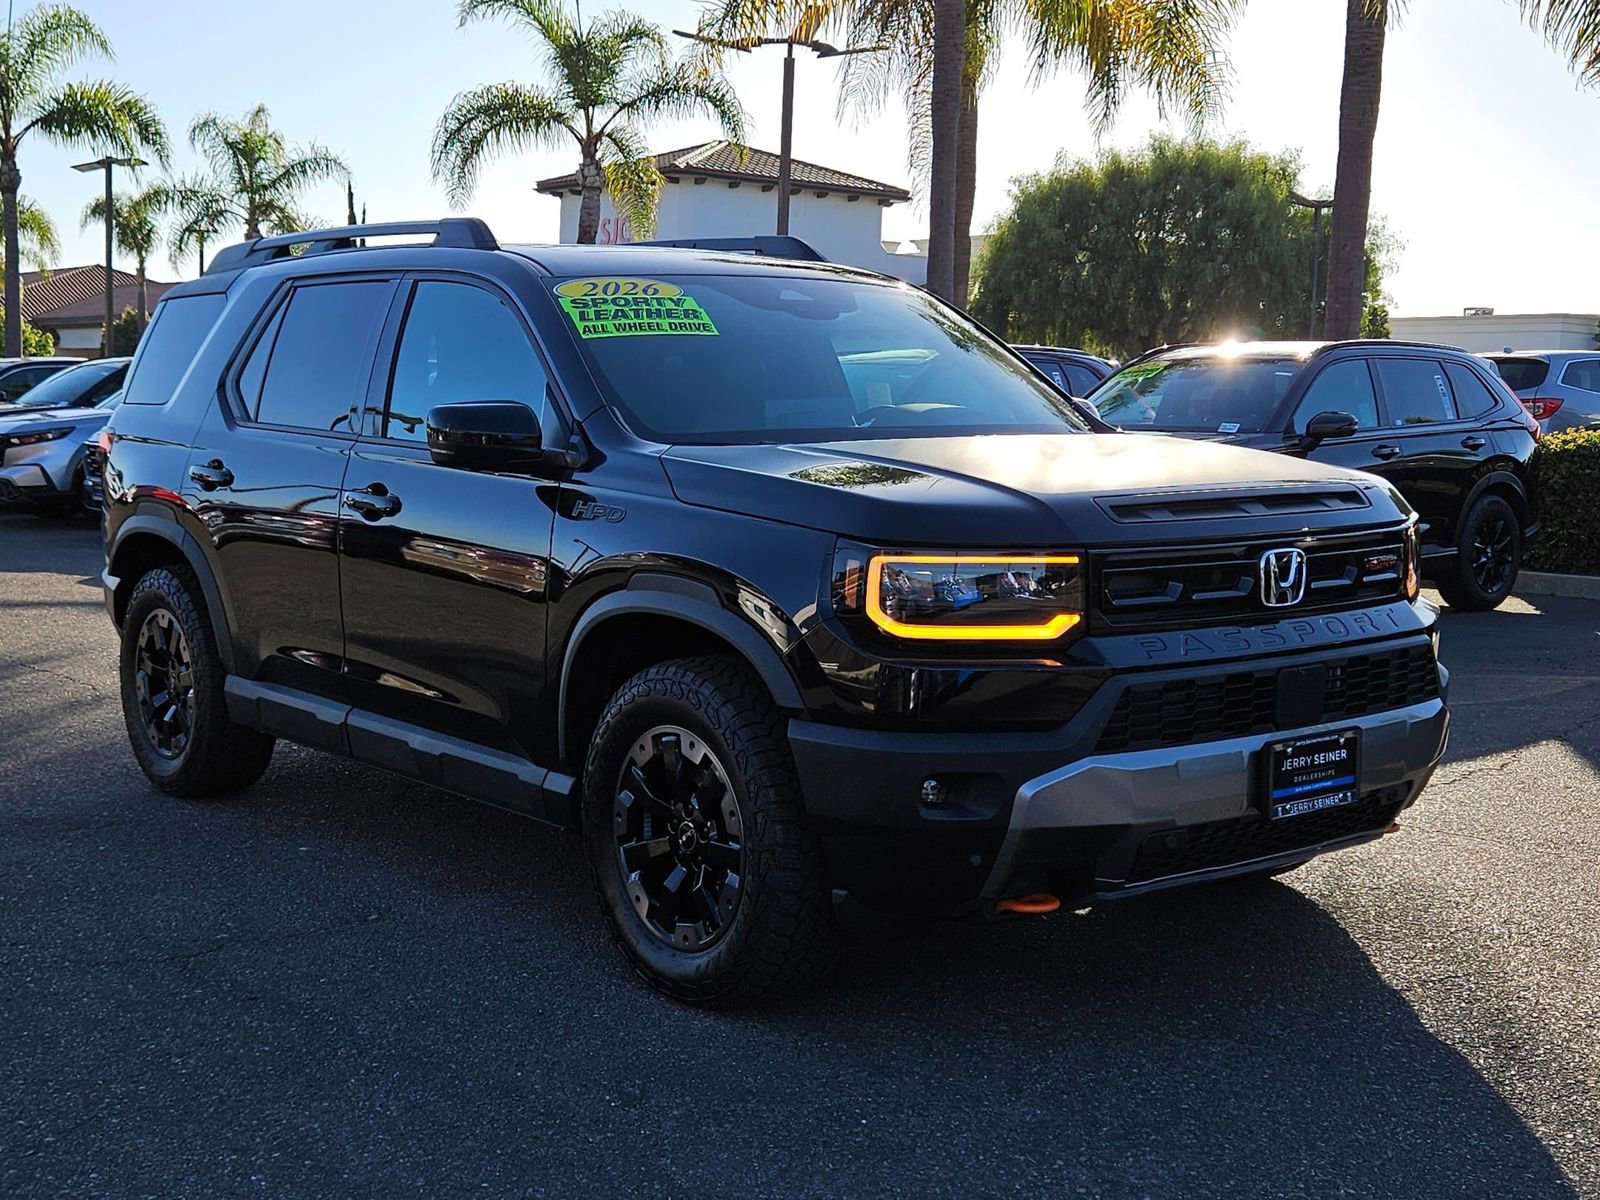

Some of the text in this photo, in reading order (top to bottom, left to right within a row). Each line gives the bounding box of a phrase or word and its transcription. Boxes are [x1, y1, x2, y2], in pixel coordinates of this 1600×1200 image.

[582, 281, 660, 297] 2026
[570, 296, 686, 310] SPORTY
[579, 308, 702, 321] LEATHER
[582, 322, 712, 334] ALL WHEEL DRIVE
[572, 500, 627, 523] HPD
[1138, 607, 1400, 660] PASSPORT
[1282, 750, 1347, 770] JERRY SEINER
[1294, 769, 1335, 782] DEALERSHIPS
[1290, 797, 1339, 814] JERRY SEINER
